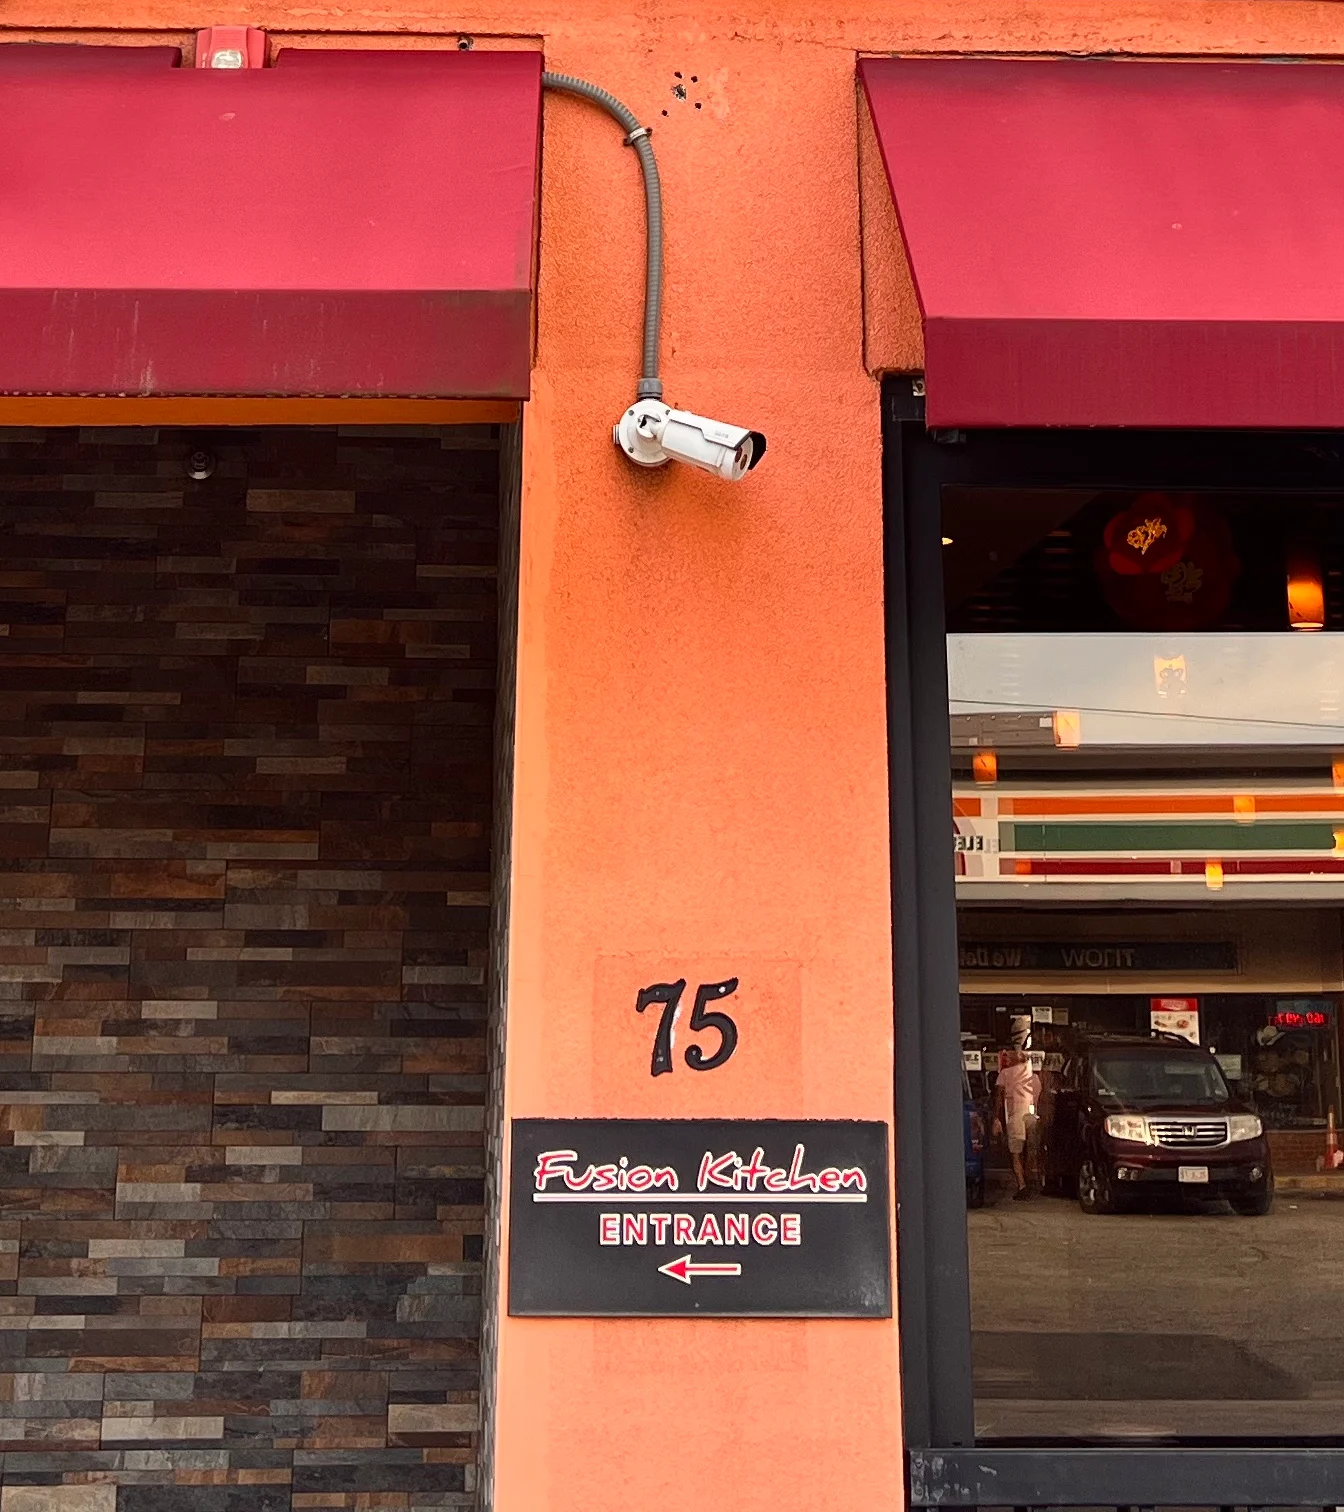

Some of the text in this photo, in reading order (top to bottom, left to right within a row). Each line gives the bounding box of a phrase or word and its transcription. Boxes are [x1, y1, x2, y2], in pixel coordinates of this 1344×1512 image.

[636, 977, 739, 1077] 75
[533, 1144, 867, 1192] Fusion Kitchen
[599, 1213, 802, 1246] ENTRANCE
